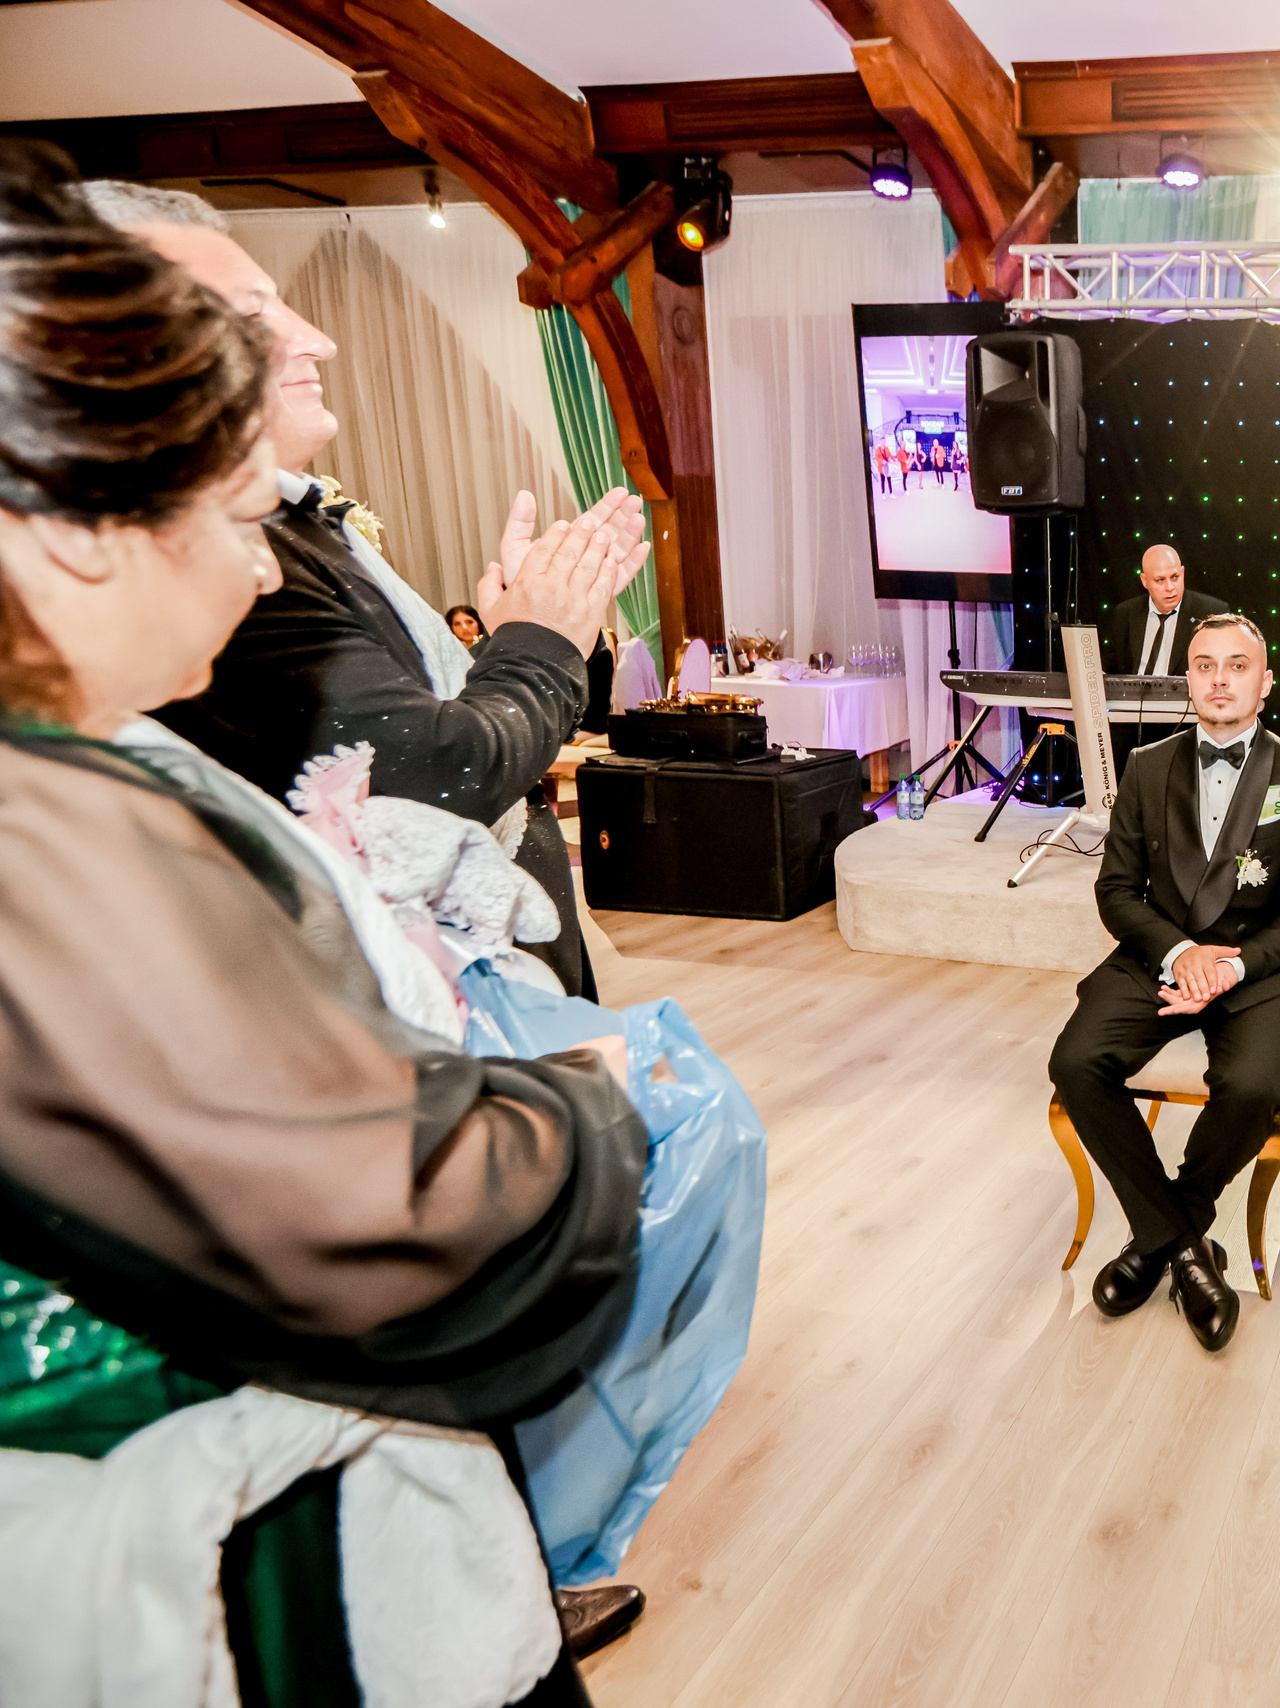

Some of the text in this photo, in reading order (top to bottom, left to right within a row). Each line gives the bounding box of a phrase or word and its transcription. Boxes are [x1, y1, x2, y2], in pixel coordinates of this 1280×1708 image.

[1081, 633, 1096, 668] PRO
[1087, 670, 1103, 728] SPIDER
[1097, 732, 1105, 759] MEYER
